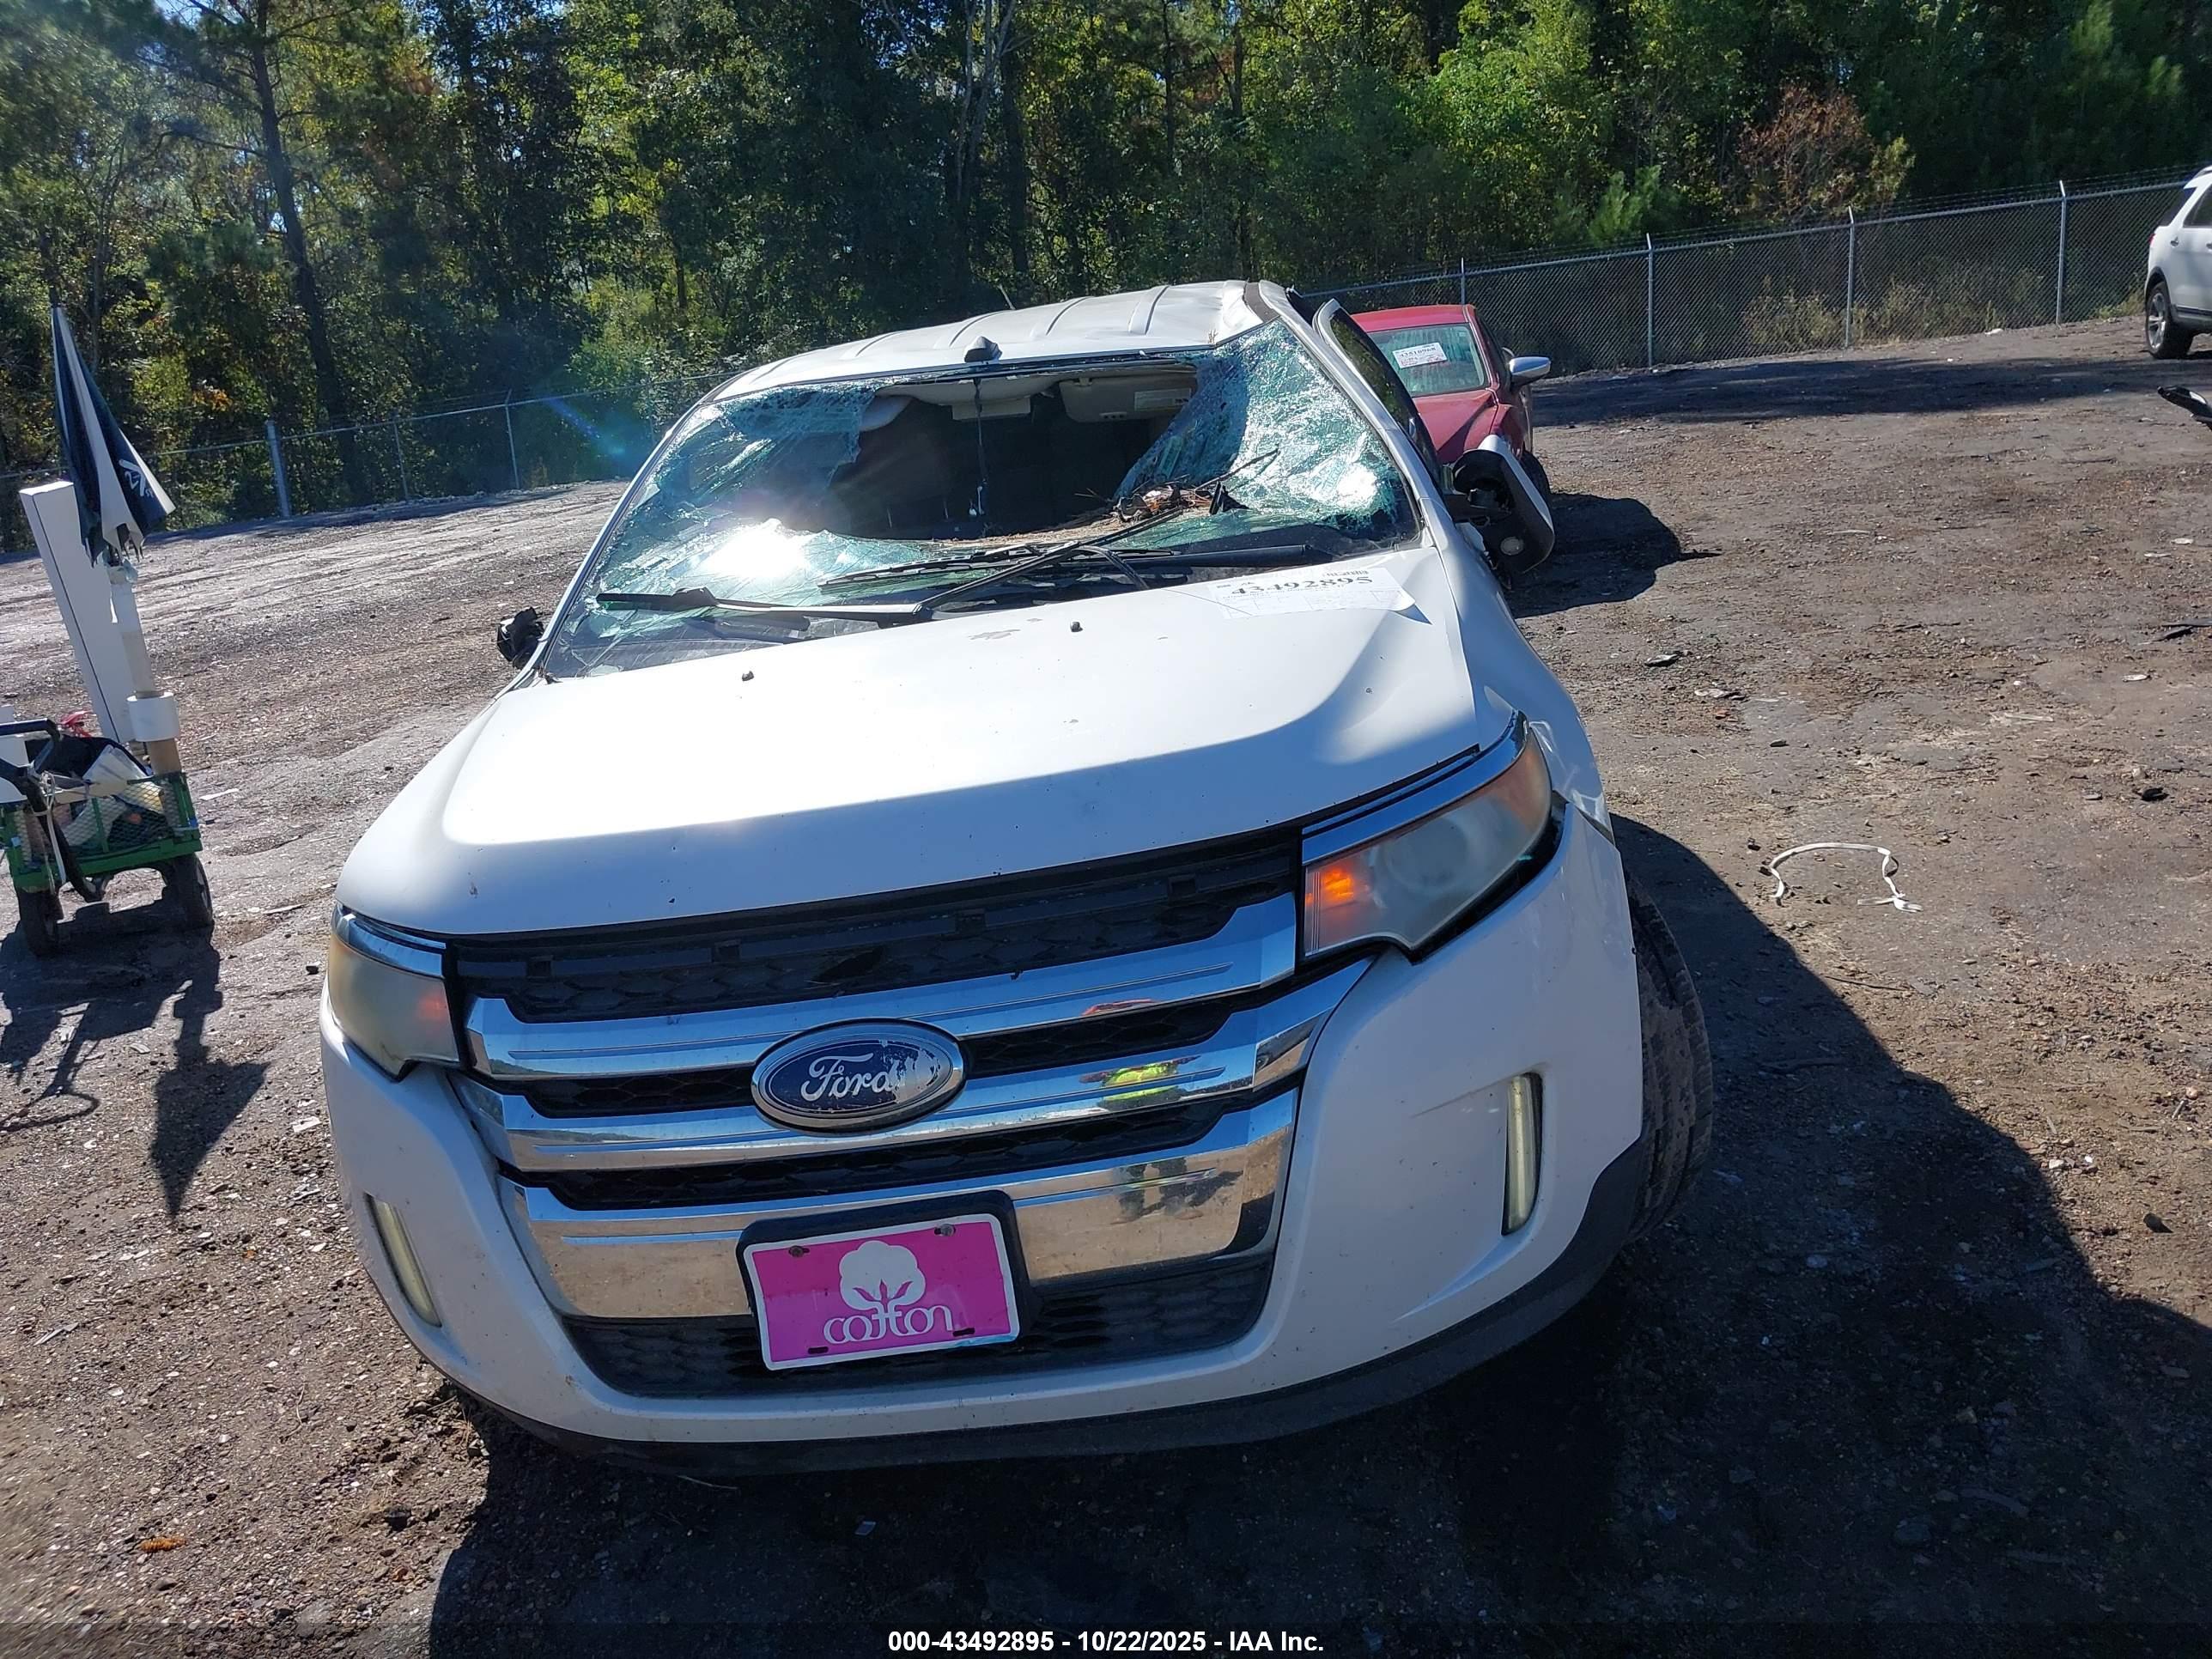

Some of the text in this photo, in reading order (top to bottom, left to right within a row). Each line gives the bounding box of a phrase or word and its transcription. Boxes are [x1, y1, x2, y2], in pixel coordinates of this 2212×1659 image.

[1231, 576, 1373, 594] 43492895
[801, 1053, 898, 1102] Ford
[823, 1305, 953, 1345] cotton
